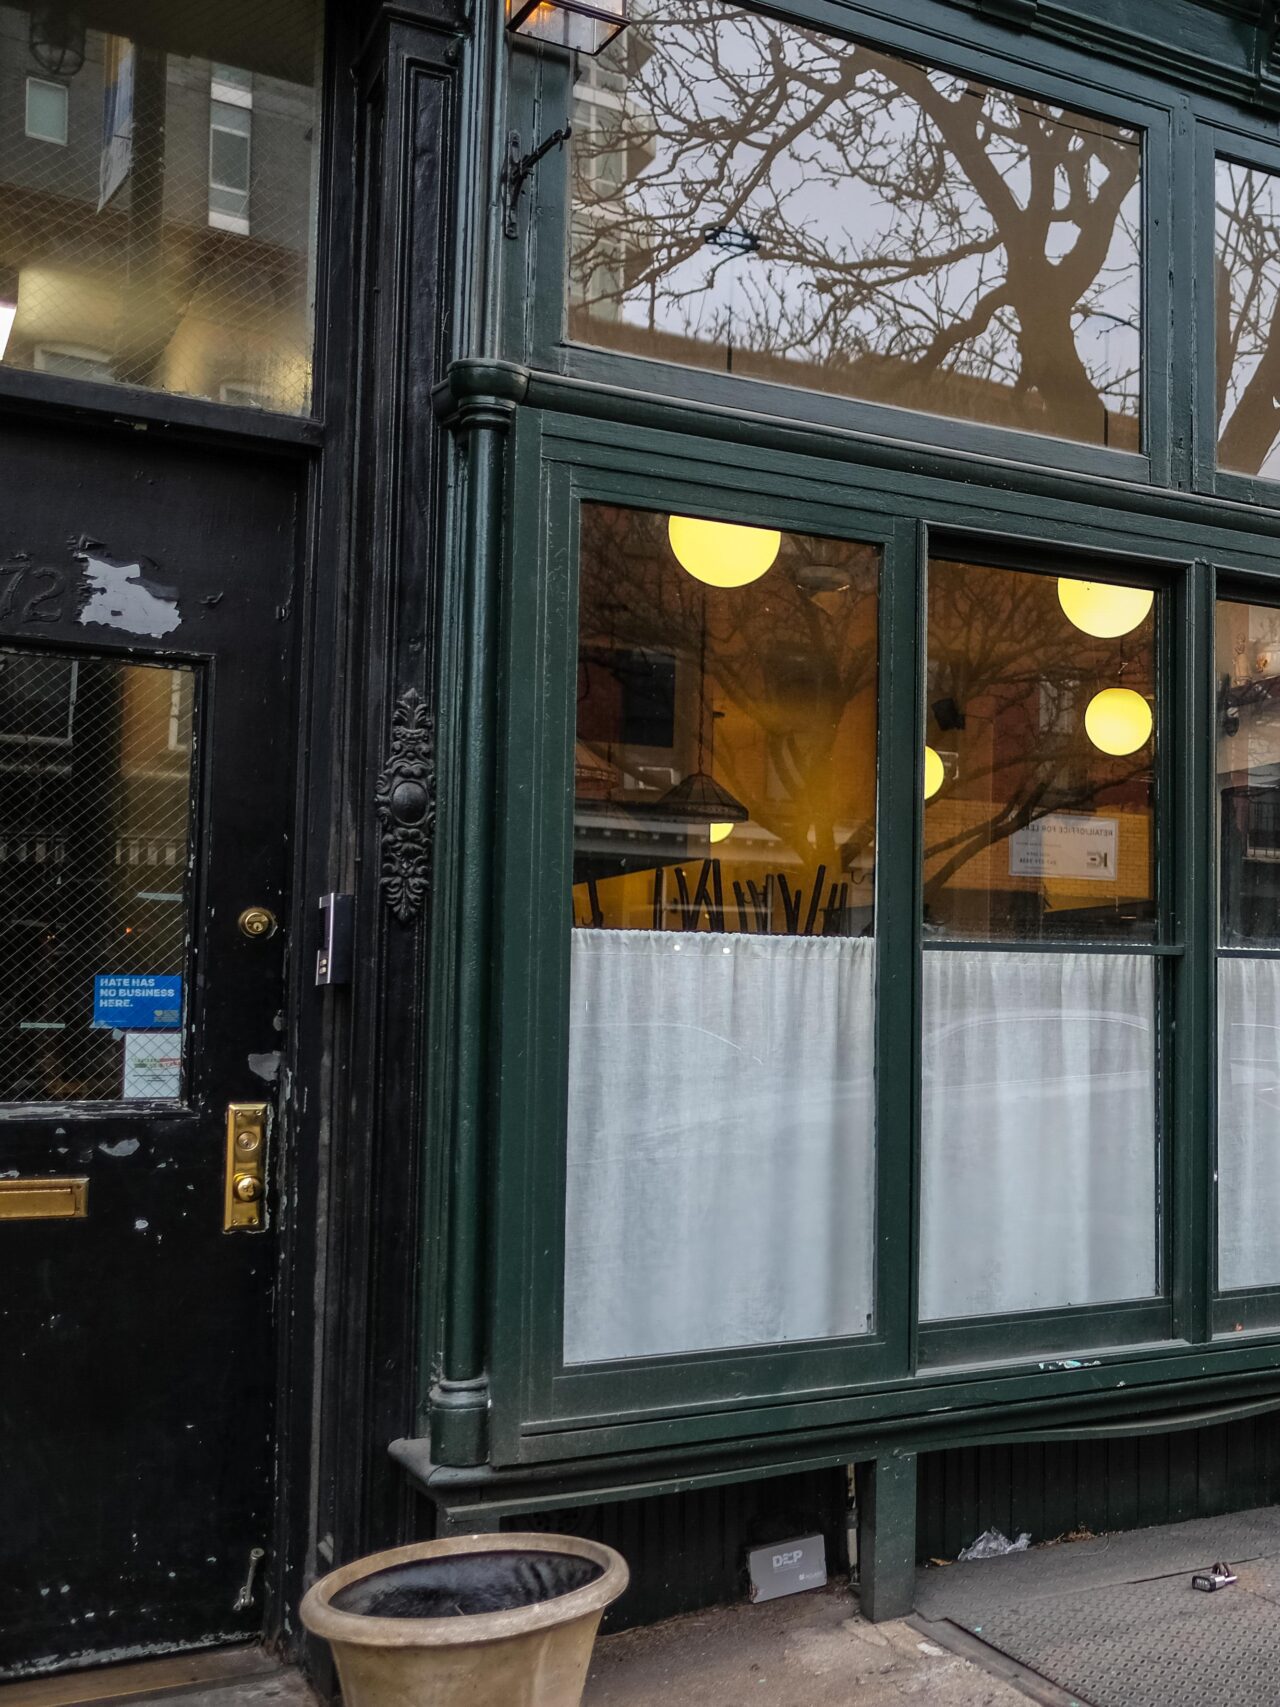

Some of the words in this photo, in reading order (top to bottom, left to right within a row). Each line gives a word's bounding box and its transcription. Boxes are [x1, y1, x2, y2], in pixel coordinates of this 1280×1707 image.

[100, 978, 130, 987] HATE
[132, 978, 155, 987] HAS
[99, 988, 116, 997] NO
[118, 988, 175, 997] BUSINESS
[99, 998, 134, 1008] HERE.
[772, 1549, 803, 1569] DEP
